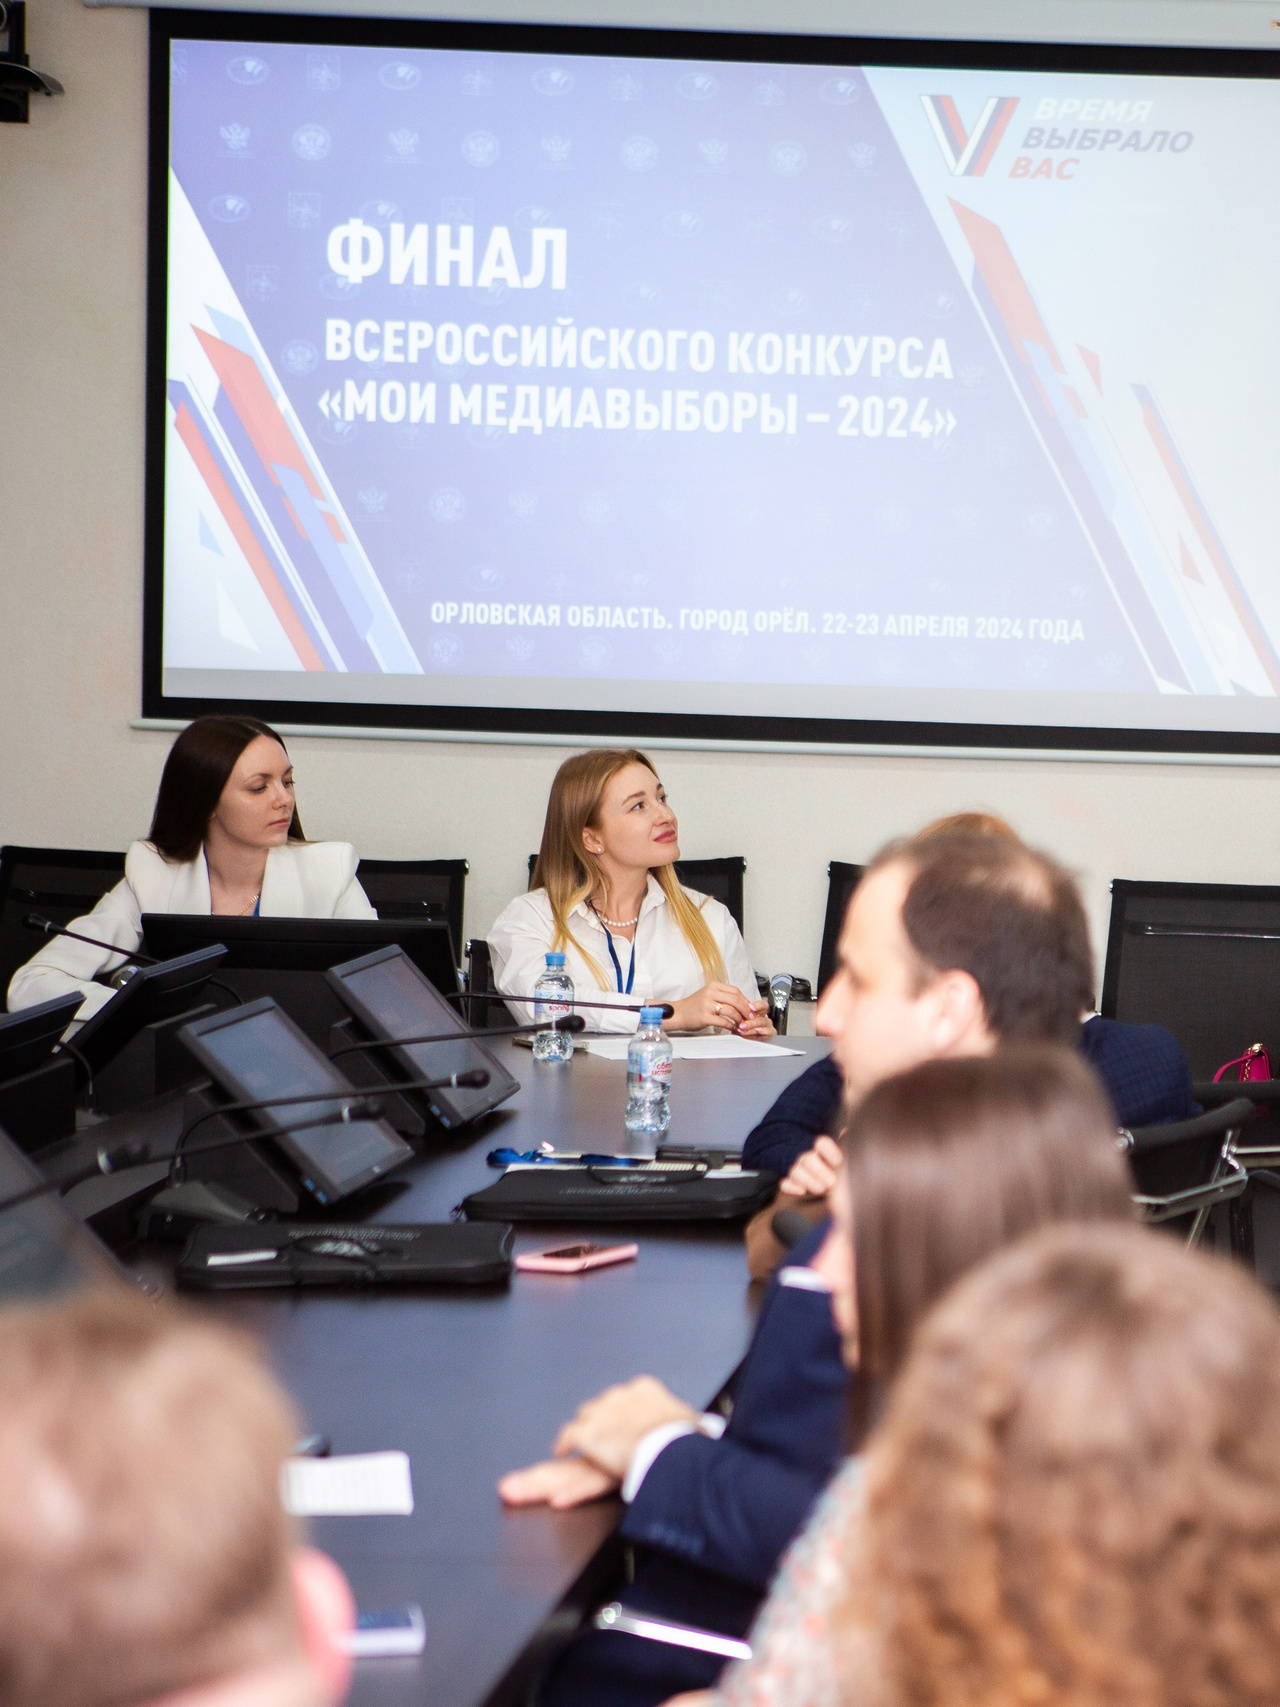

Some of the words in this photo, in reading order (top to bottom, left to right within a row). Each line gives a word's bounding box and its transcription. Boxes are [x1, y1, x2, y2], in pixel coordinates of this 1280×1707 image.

[1033, 98, 1153, 123] ВРЕМЯ
[1021, 127, 1194, 153] ВЫБРАЛО
[1008, 157, 1080, 180] ВАС
[327, 218, 567, 290] ФИНАЛ
[325, 317, 715, 373] ВСЕРОССИЙСКОГО
[728, 331, 954, 379] КОНКУРСА
[317, 379, 436, 424] «МОИ
[449, 382, 797, 435] МЕДИАВЫБОРЫ
[838, 395, 957, 438] 2024»
[430, 602, 560, 626] ОРЛОВСКАЯ
[567, 605, 673, 630] ОБЛАСТЬ.
[679, 608, 750, 635] ГОРОД
[754, 607, 816, 633] ОРЁЛ.
[822, 613, 879, 635] 22-23
[883, 614, 968, 637] АПРЕЛЯ
[975, 617, 1023, 639] 2024
[1029, 618, 1085, 644] ГОДА
